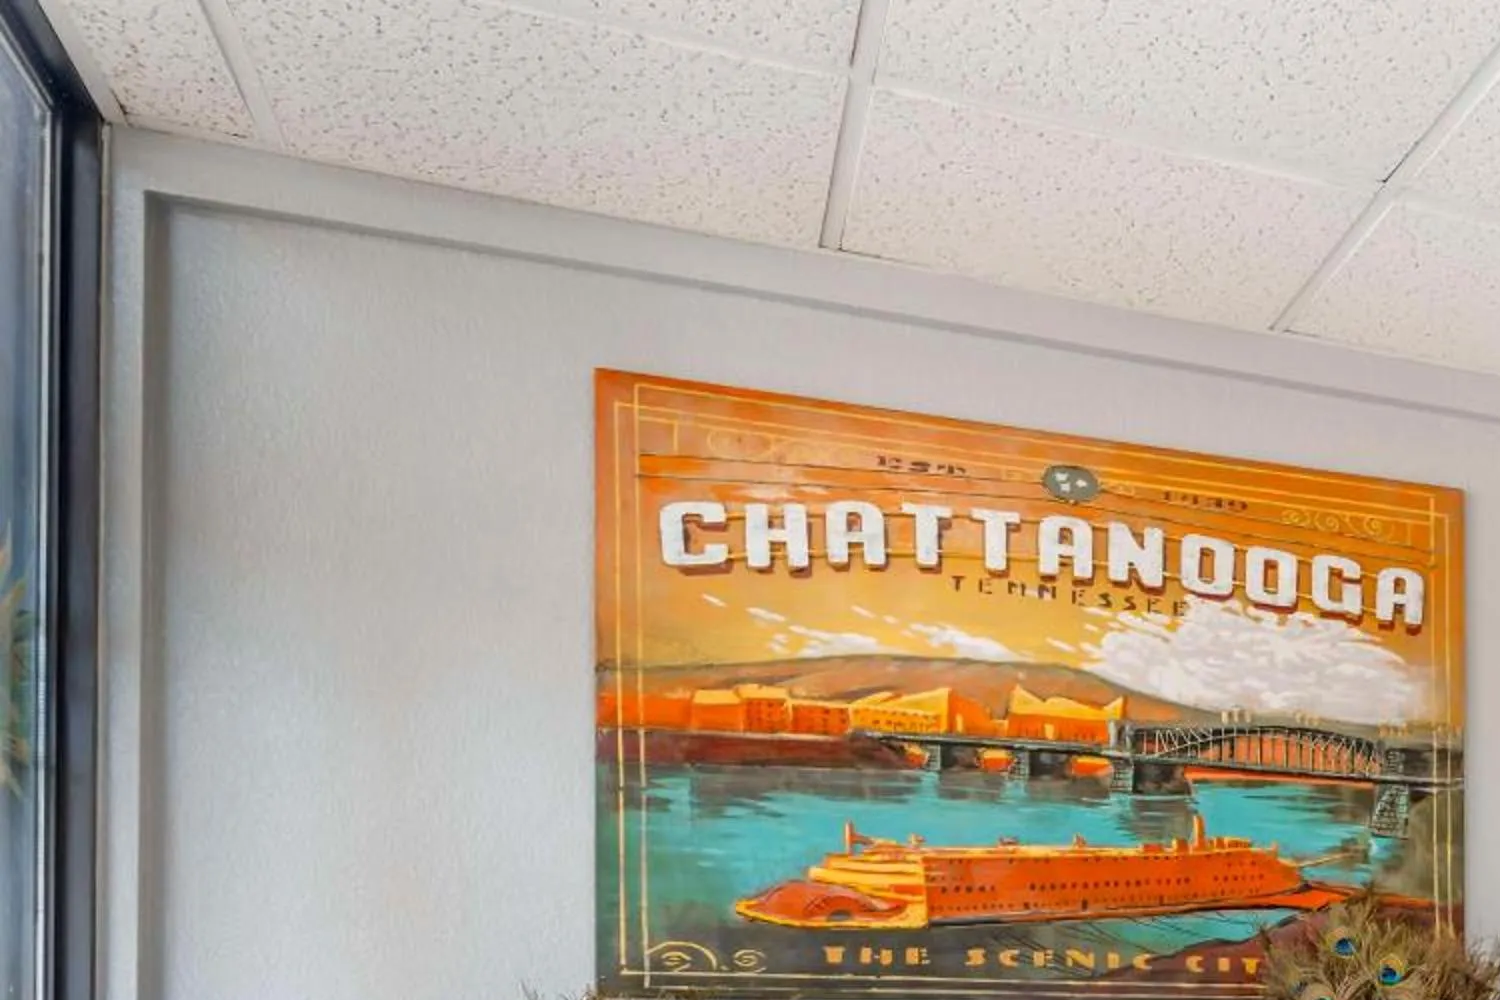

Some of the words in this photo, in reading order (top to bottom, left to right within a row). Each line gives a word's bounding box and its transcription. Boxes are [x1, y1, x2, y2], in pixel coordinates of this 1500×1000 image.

[660, 499, 1425, 630] CHATTANOOGA
[951, 574, 1186, 617] TENNESSEE
[823, 945, 931, 967] THE
[964, 947, 1154, 971] SCENIC
[1187, 954, 1266, 975] CIT
